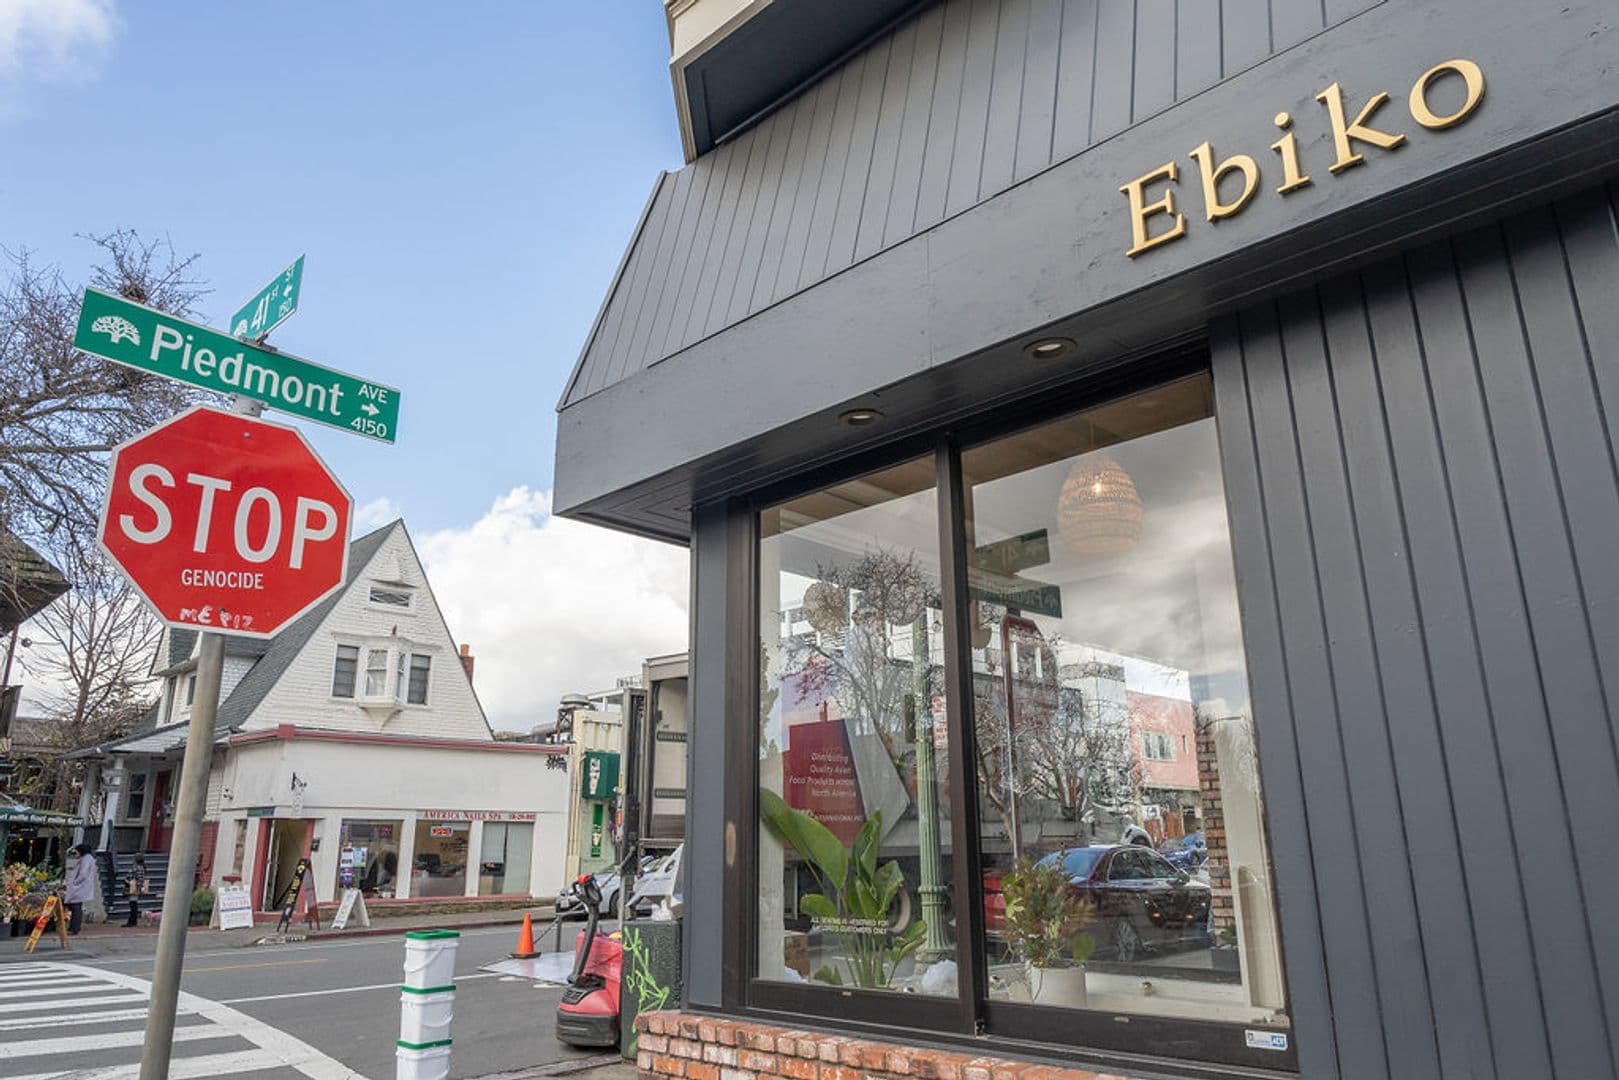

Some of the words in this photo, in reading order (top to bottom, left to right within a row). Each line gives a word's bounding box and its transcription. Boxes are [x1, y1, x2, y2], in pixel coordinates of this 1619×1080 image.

[1119, 58, 1487, 259] Ebiko
[149, 323, 344, 416] Piedmont
[358, 383, 388, 404] AVE
[350, 416, 388, 438] 4150
[119, 463, 339, 570] STOP
[181, 568, 264, 590] GENOCIDE
[810, 764, 833, 775] Quality
